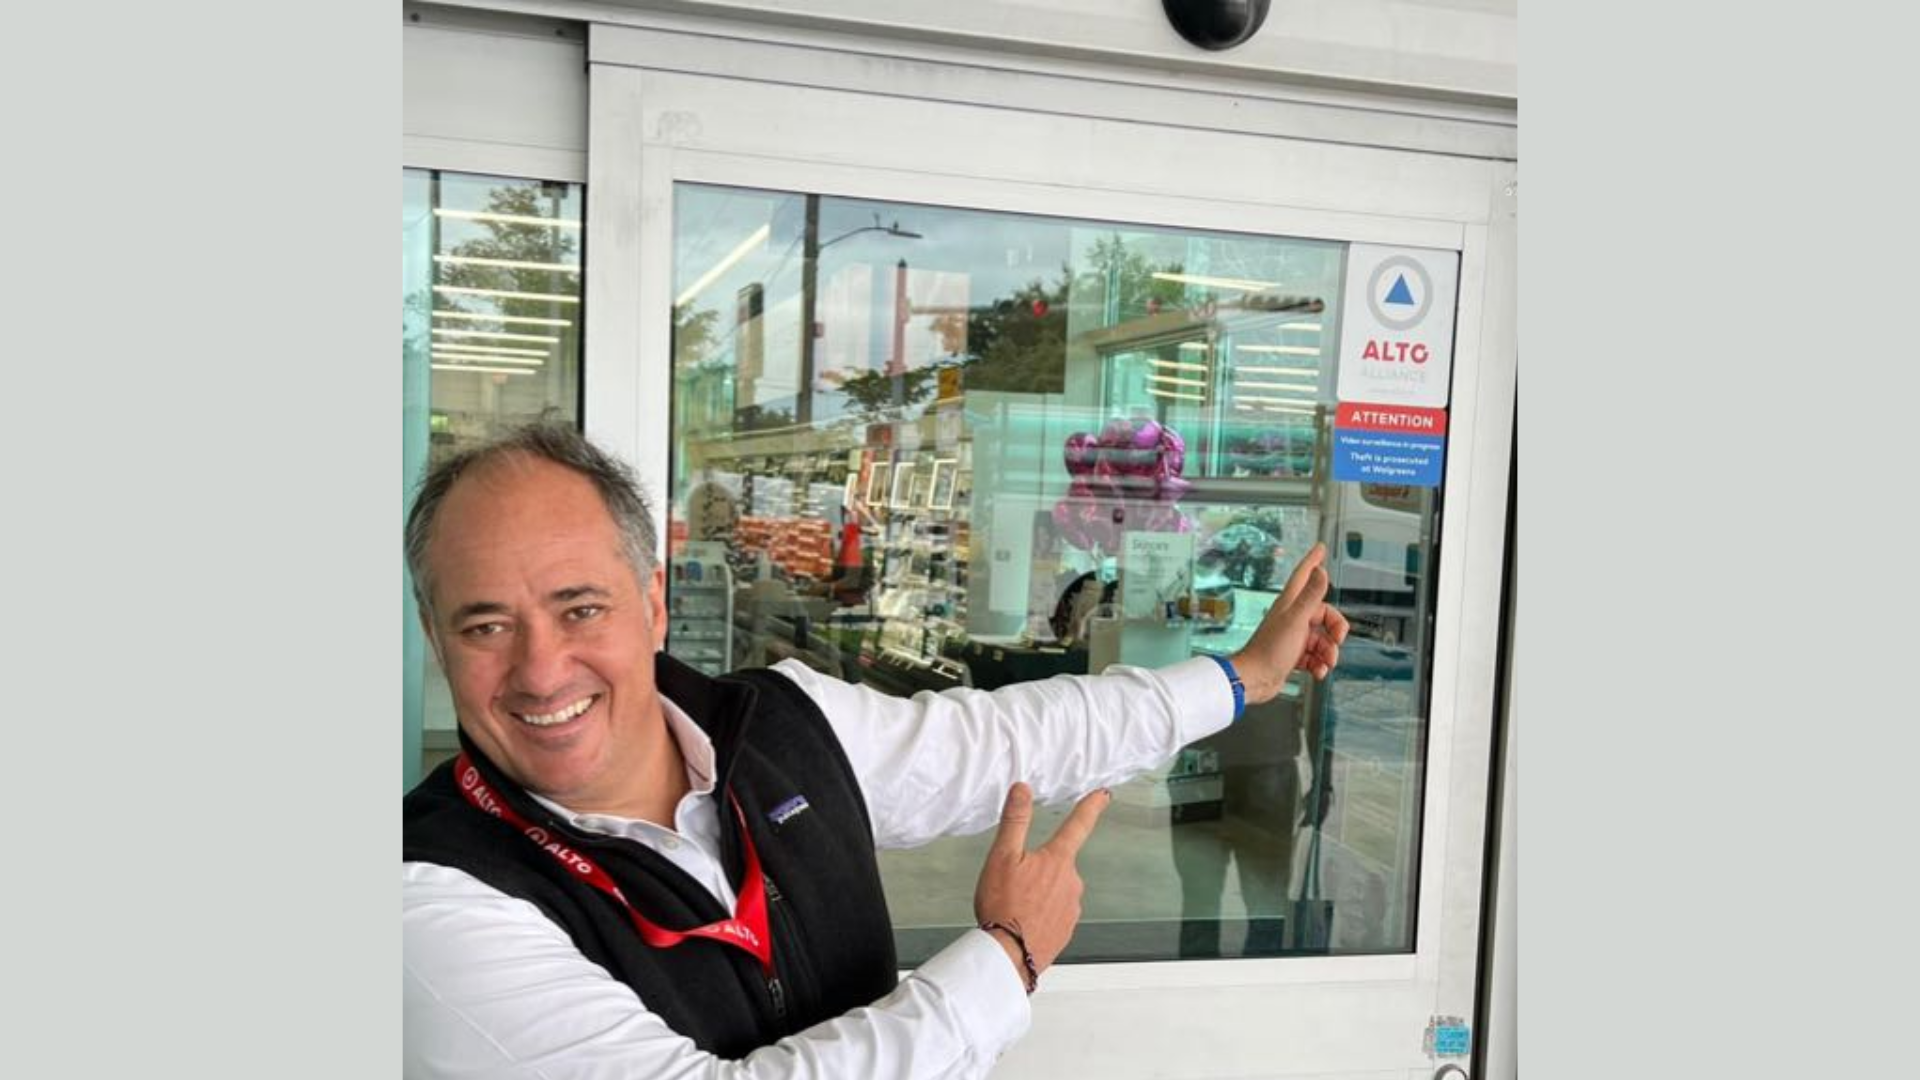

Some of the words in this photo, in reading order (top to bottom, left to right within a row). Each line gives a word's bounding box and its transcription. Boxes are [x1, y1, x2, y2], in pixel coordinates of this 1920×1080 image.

[1362, 339, 1429, 364] ALTO
[1351, 410, 1434, 429] ATTENTION
[1340, 436, 1361, 445] Video
[1362, 438, 1402, 448] surveillance
[1410, 442, 1441, 452] progress
[1350, 451, 1373, 463] Theft
[1374, 454, 1381, 463] is
[1382, 454, 1430, 466] prosecuted
[1361, 465, 1371, 474] at
[1372, 465, 1417, 477] Walgreens
[544, 843, 592, 874] ALTO
